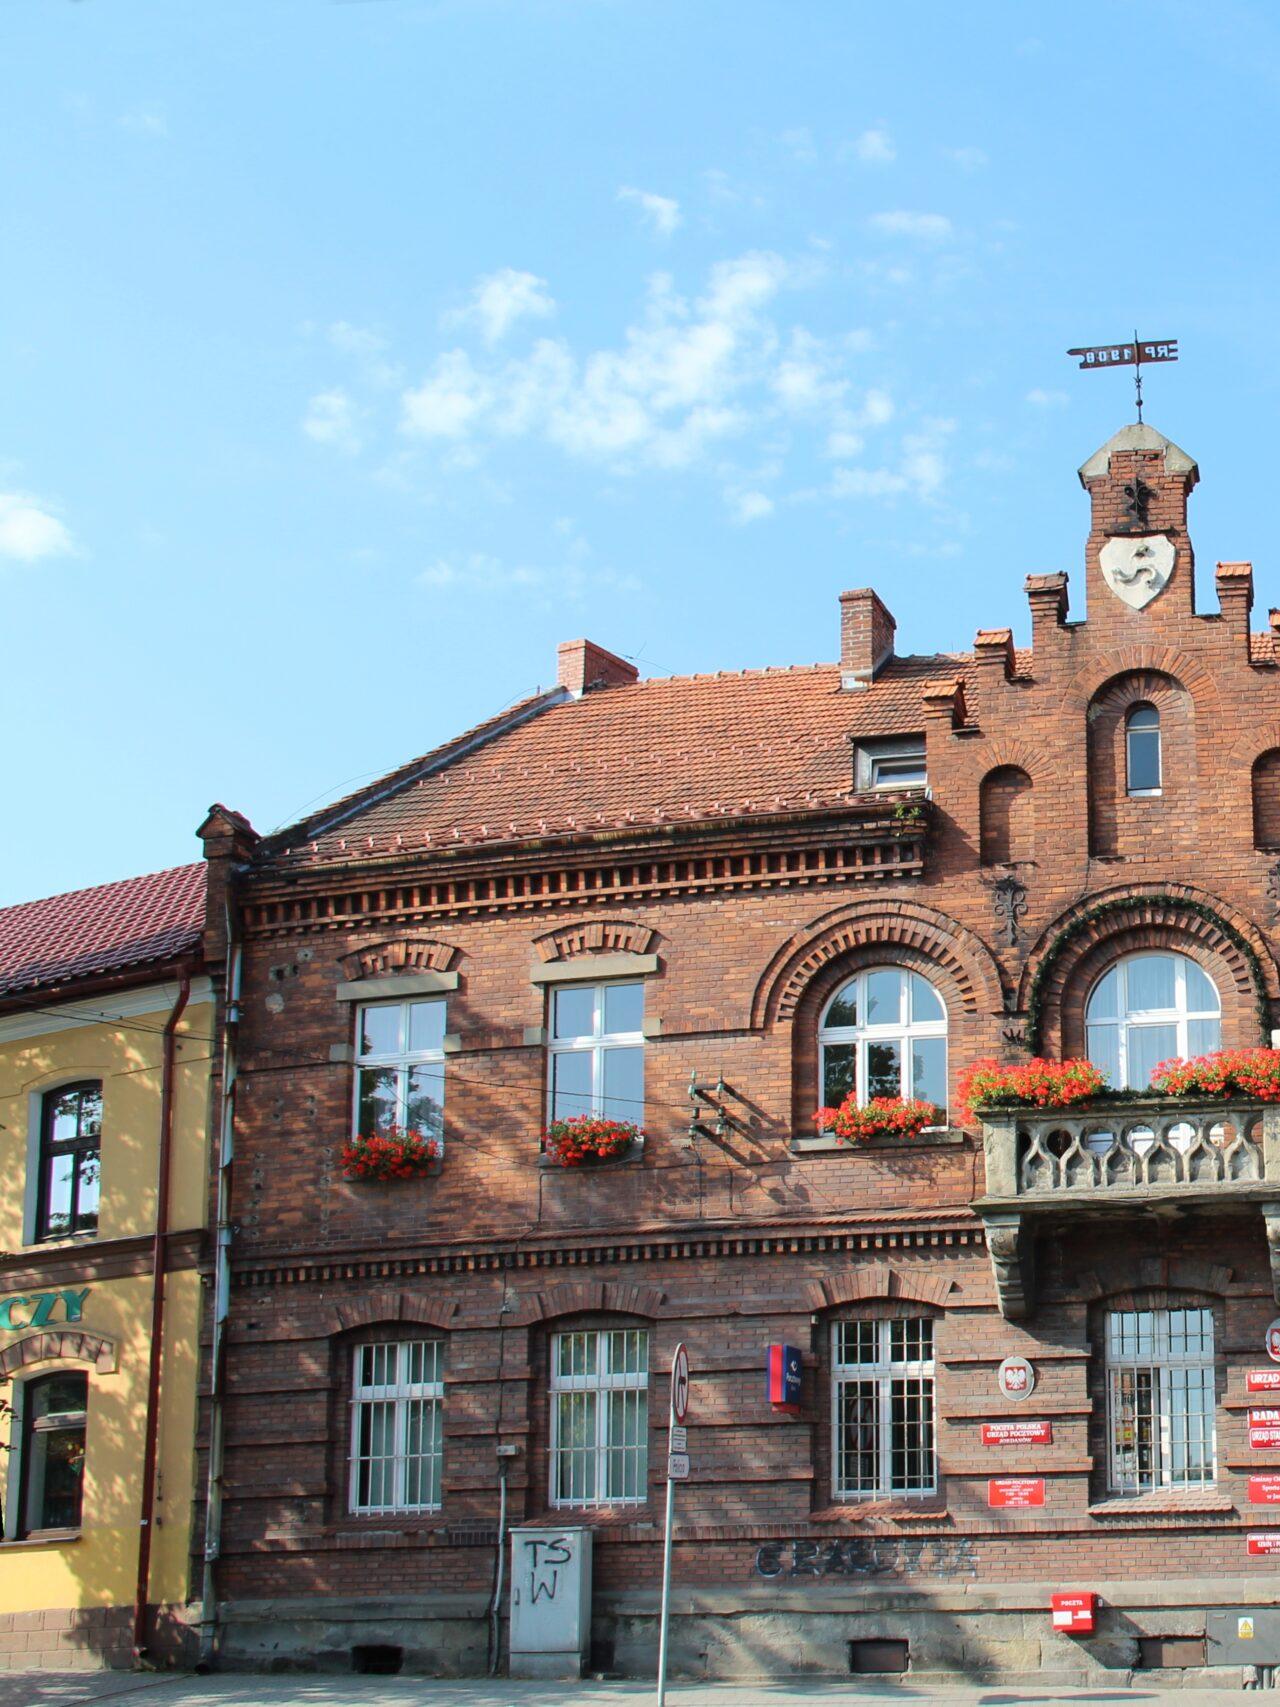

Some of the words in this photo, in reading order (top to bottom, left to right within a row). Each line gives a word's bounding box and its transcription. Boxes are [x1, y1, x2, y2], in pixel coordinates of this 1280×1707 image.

[0, 1287, 92, 1330] CZY
[1252, 1410, 1280, 1420] RADA
[524, 1538, 571, 1568] TS
[531, 1570, 557, 1604] W
